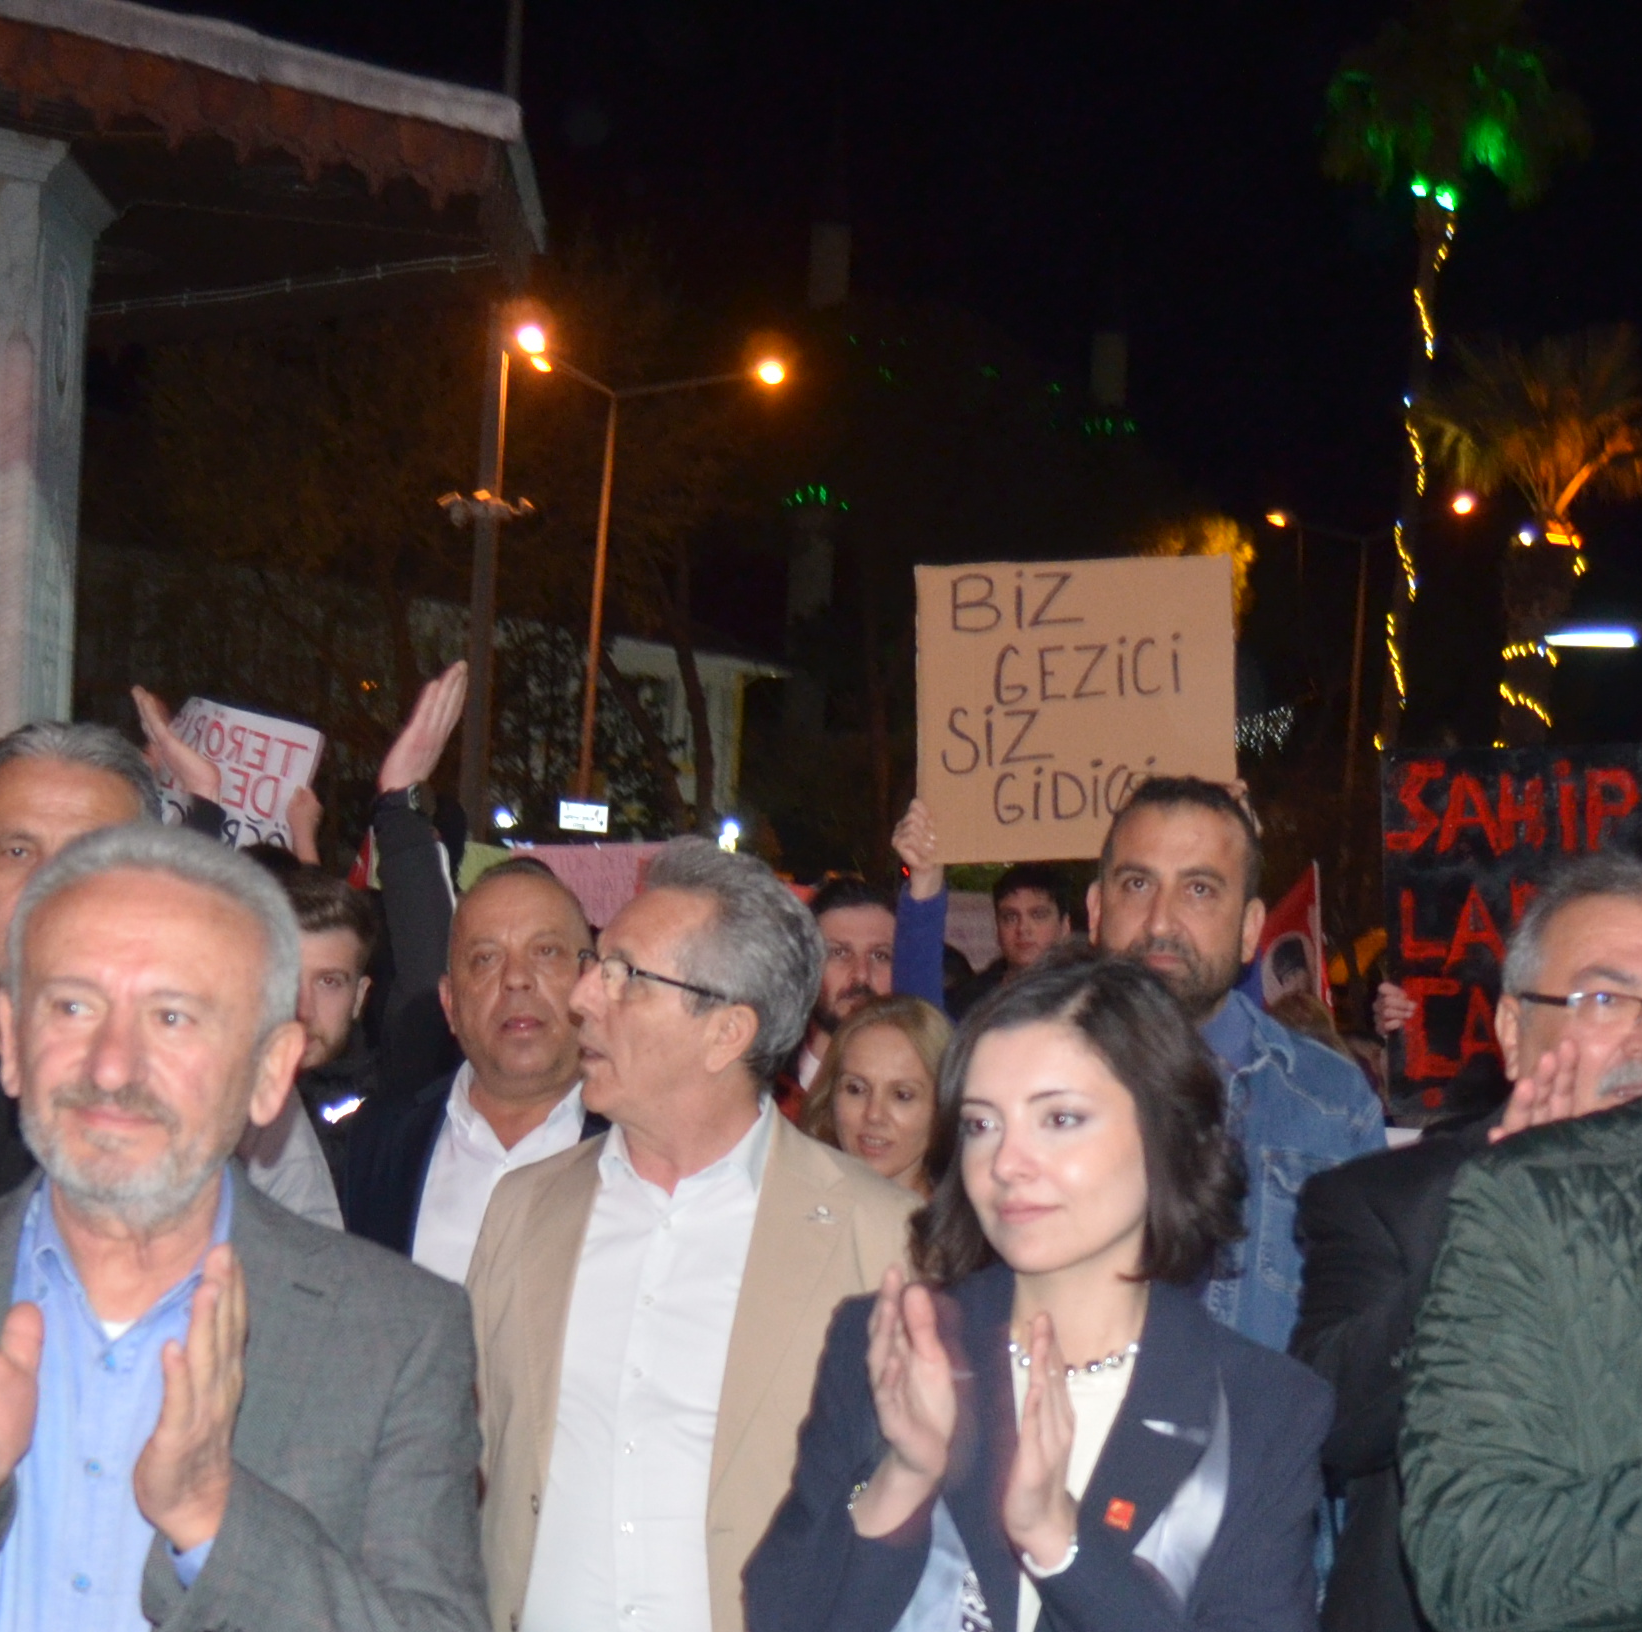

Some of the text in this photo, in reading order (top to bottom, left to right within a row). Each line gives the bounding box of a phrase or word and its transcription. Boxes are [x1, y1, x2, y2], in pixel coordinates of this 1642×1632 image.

[950, 571, 1084, 633] BİZ
[993, 632, 1181, 705] GEZİCİ
[941, 706, 1055, 774] SİZ
[994, 756, 1155, 825] GİDİC
